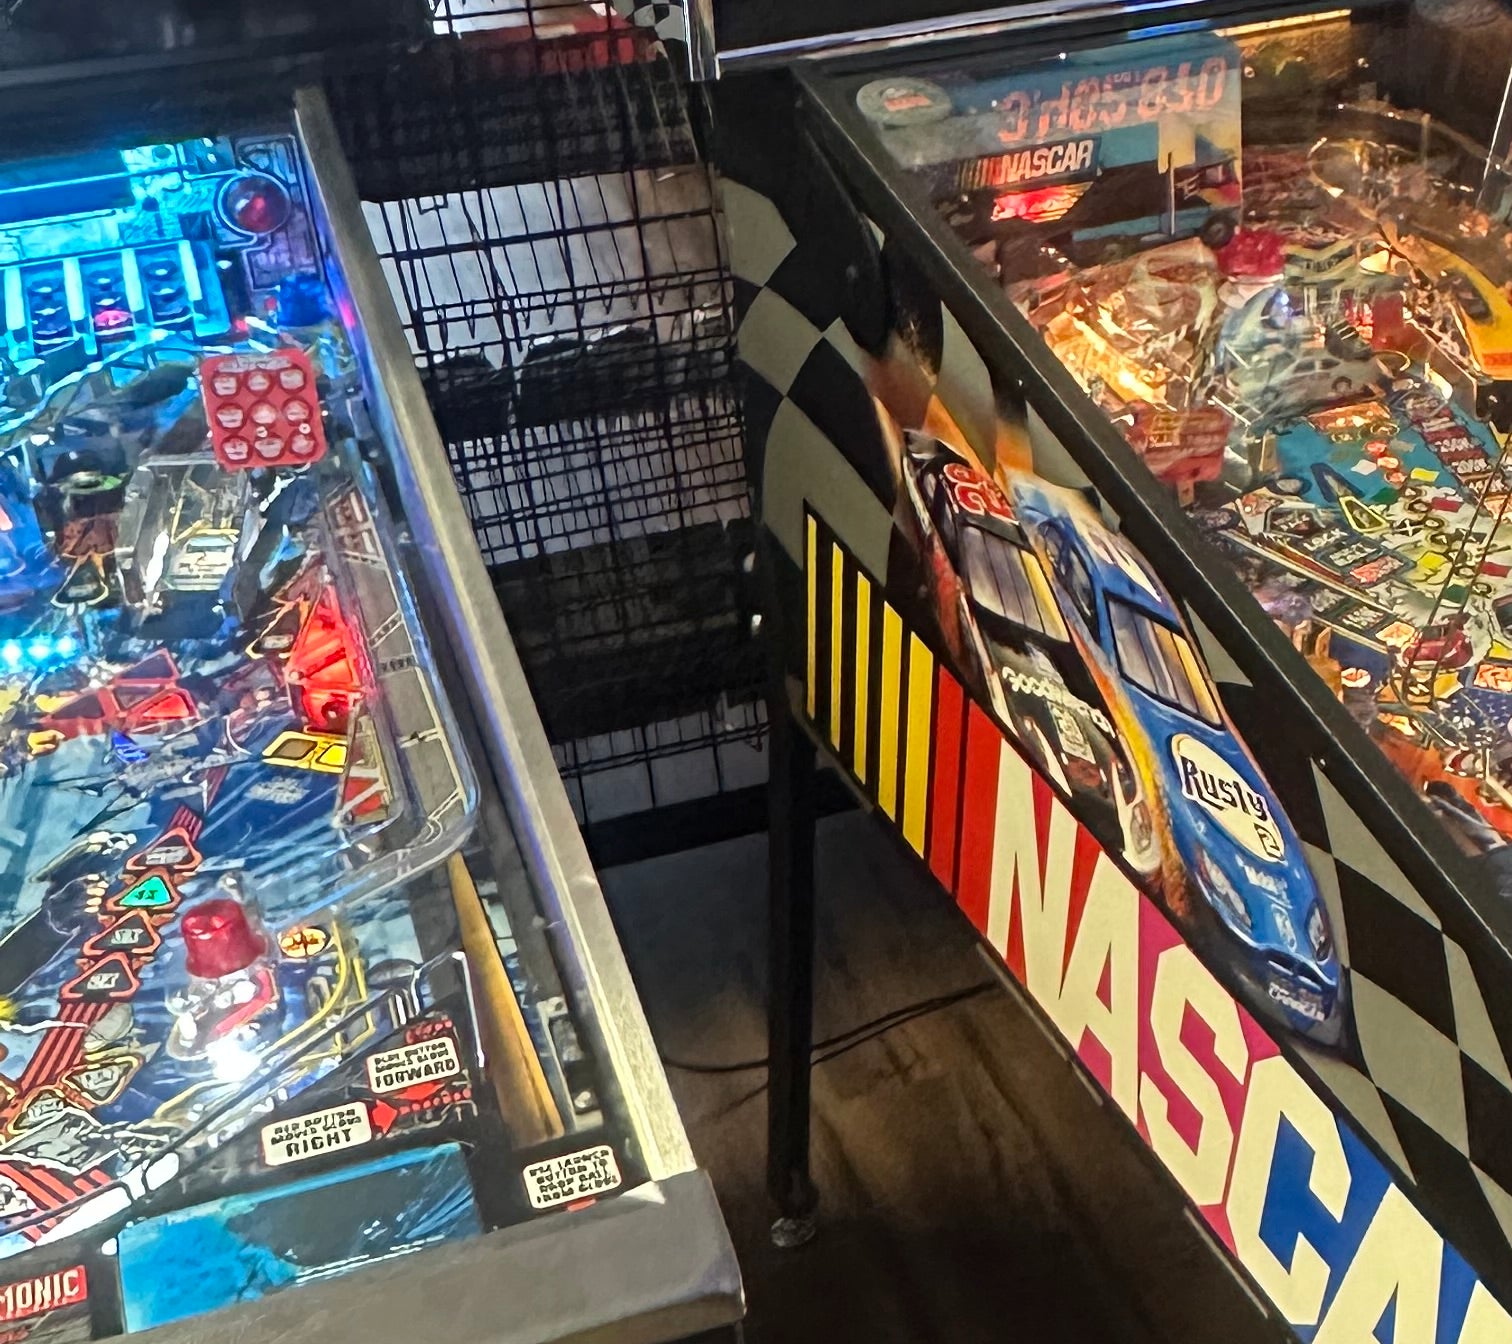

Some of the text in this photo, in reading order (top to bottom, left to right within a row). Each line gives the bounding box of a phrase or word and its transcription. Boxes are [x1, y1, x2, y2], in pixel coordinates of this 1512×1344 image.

[999, 139, 1094, 183] NASCAR
[1180, 754, 1268, 822] Rusty
[286, 1128, 351, 1157] RIGHT
